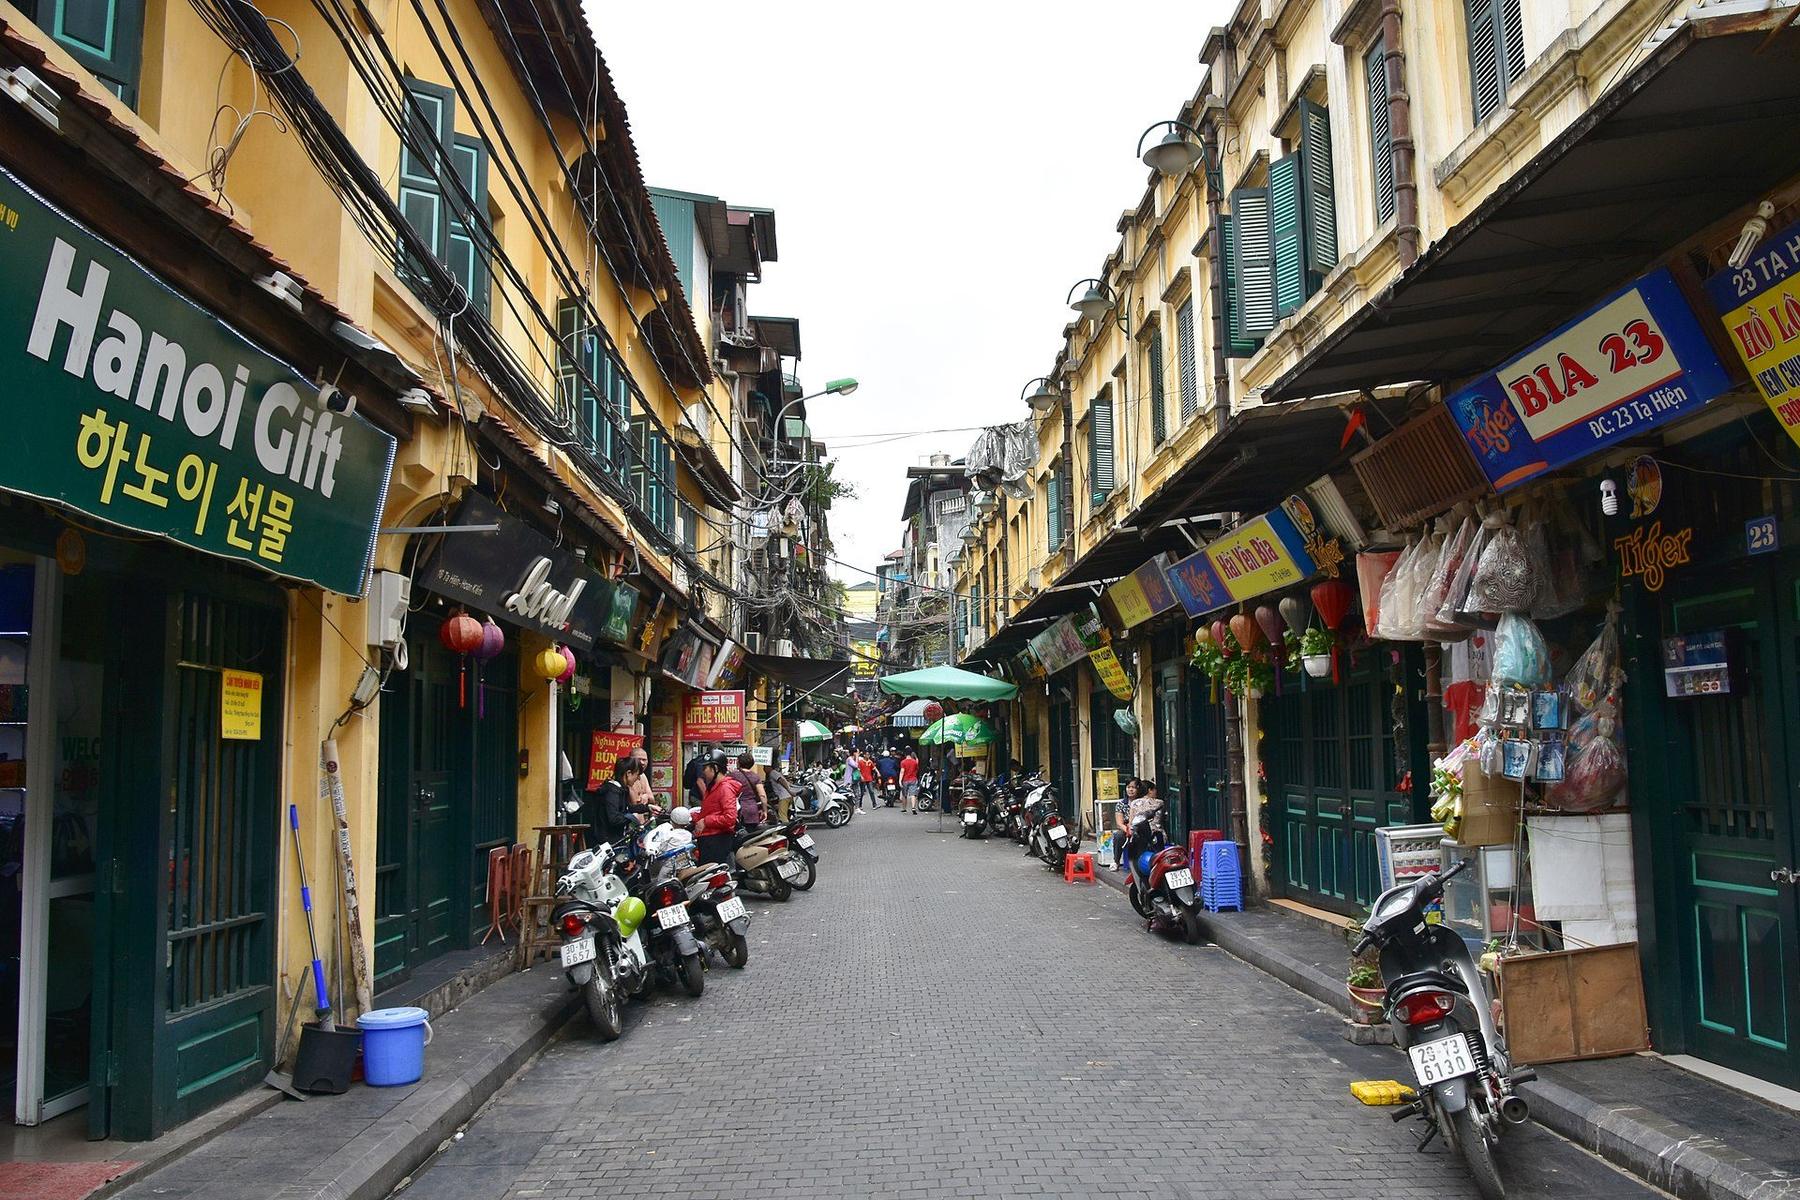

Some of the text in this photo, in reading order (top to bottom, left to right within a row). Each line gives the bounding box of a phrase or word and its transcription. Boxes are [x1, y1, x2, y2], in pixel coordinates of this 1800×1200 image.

[1732, 268, 1757, 297] 23
[1754, 249, 1788, 278] TẠ
[1733, 304, 1775, 361] HỒ
[26, 236, 343, 498] Hanoi Gift
[1508, 318, 1664, 417] BIA 23
[1756, 366, 1788, 399] NEM
[1467, 399, 1517, 455] Tiger
[1612, 407, 1632, 429] 23
[1630, 400, 1653, 422] Tạ
[1649, 386, 1687, 413] Hiện
[77, 408, 295, 564] 하노이 선물
[1614, 520, 1692, 591] Tiger
[1749, 522, 1775, 549] 23
[686, 706, 712, 724] LITTLE
[595, 749, 618, 764] BÚN
[566, 949, 591, 965] 6657
[1423, 1056, 1467, 1081] 6130
